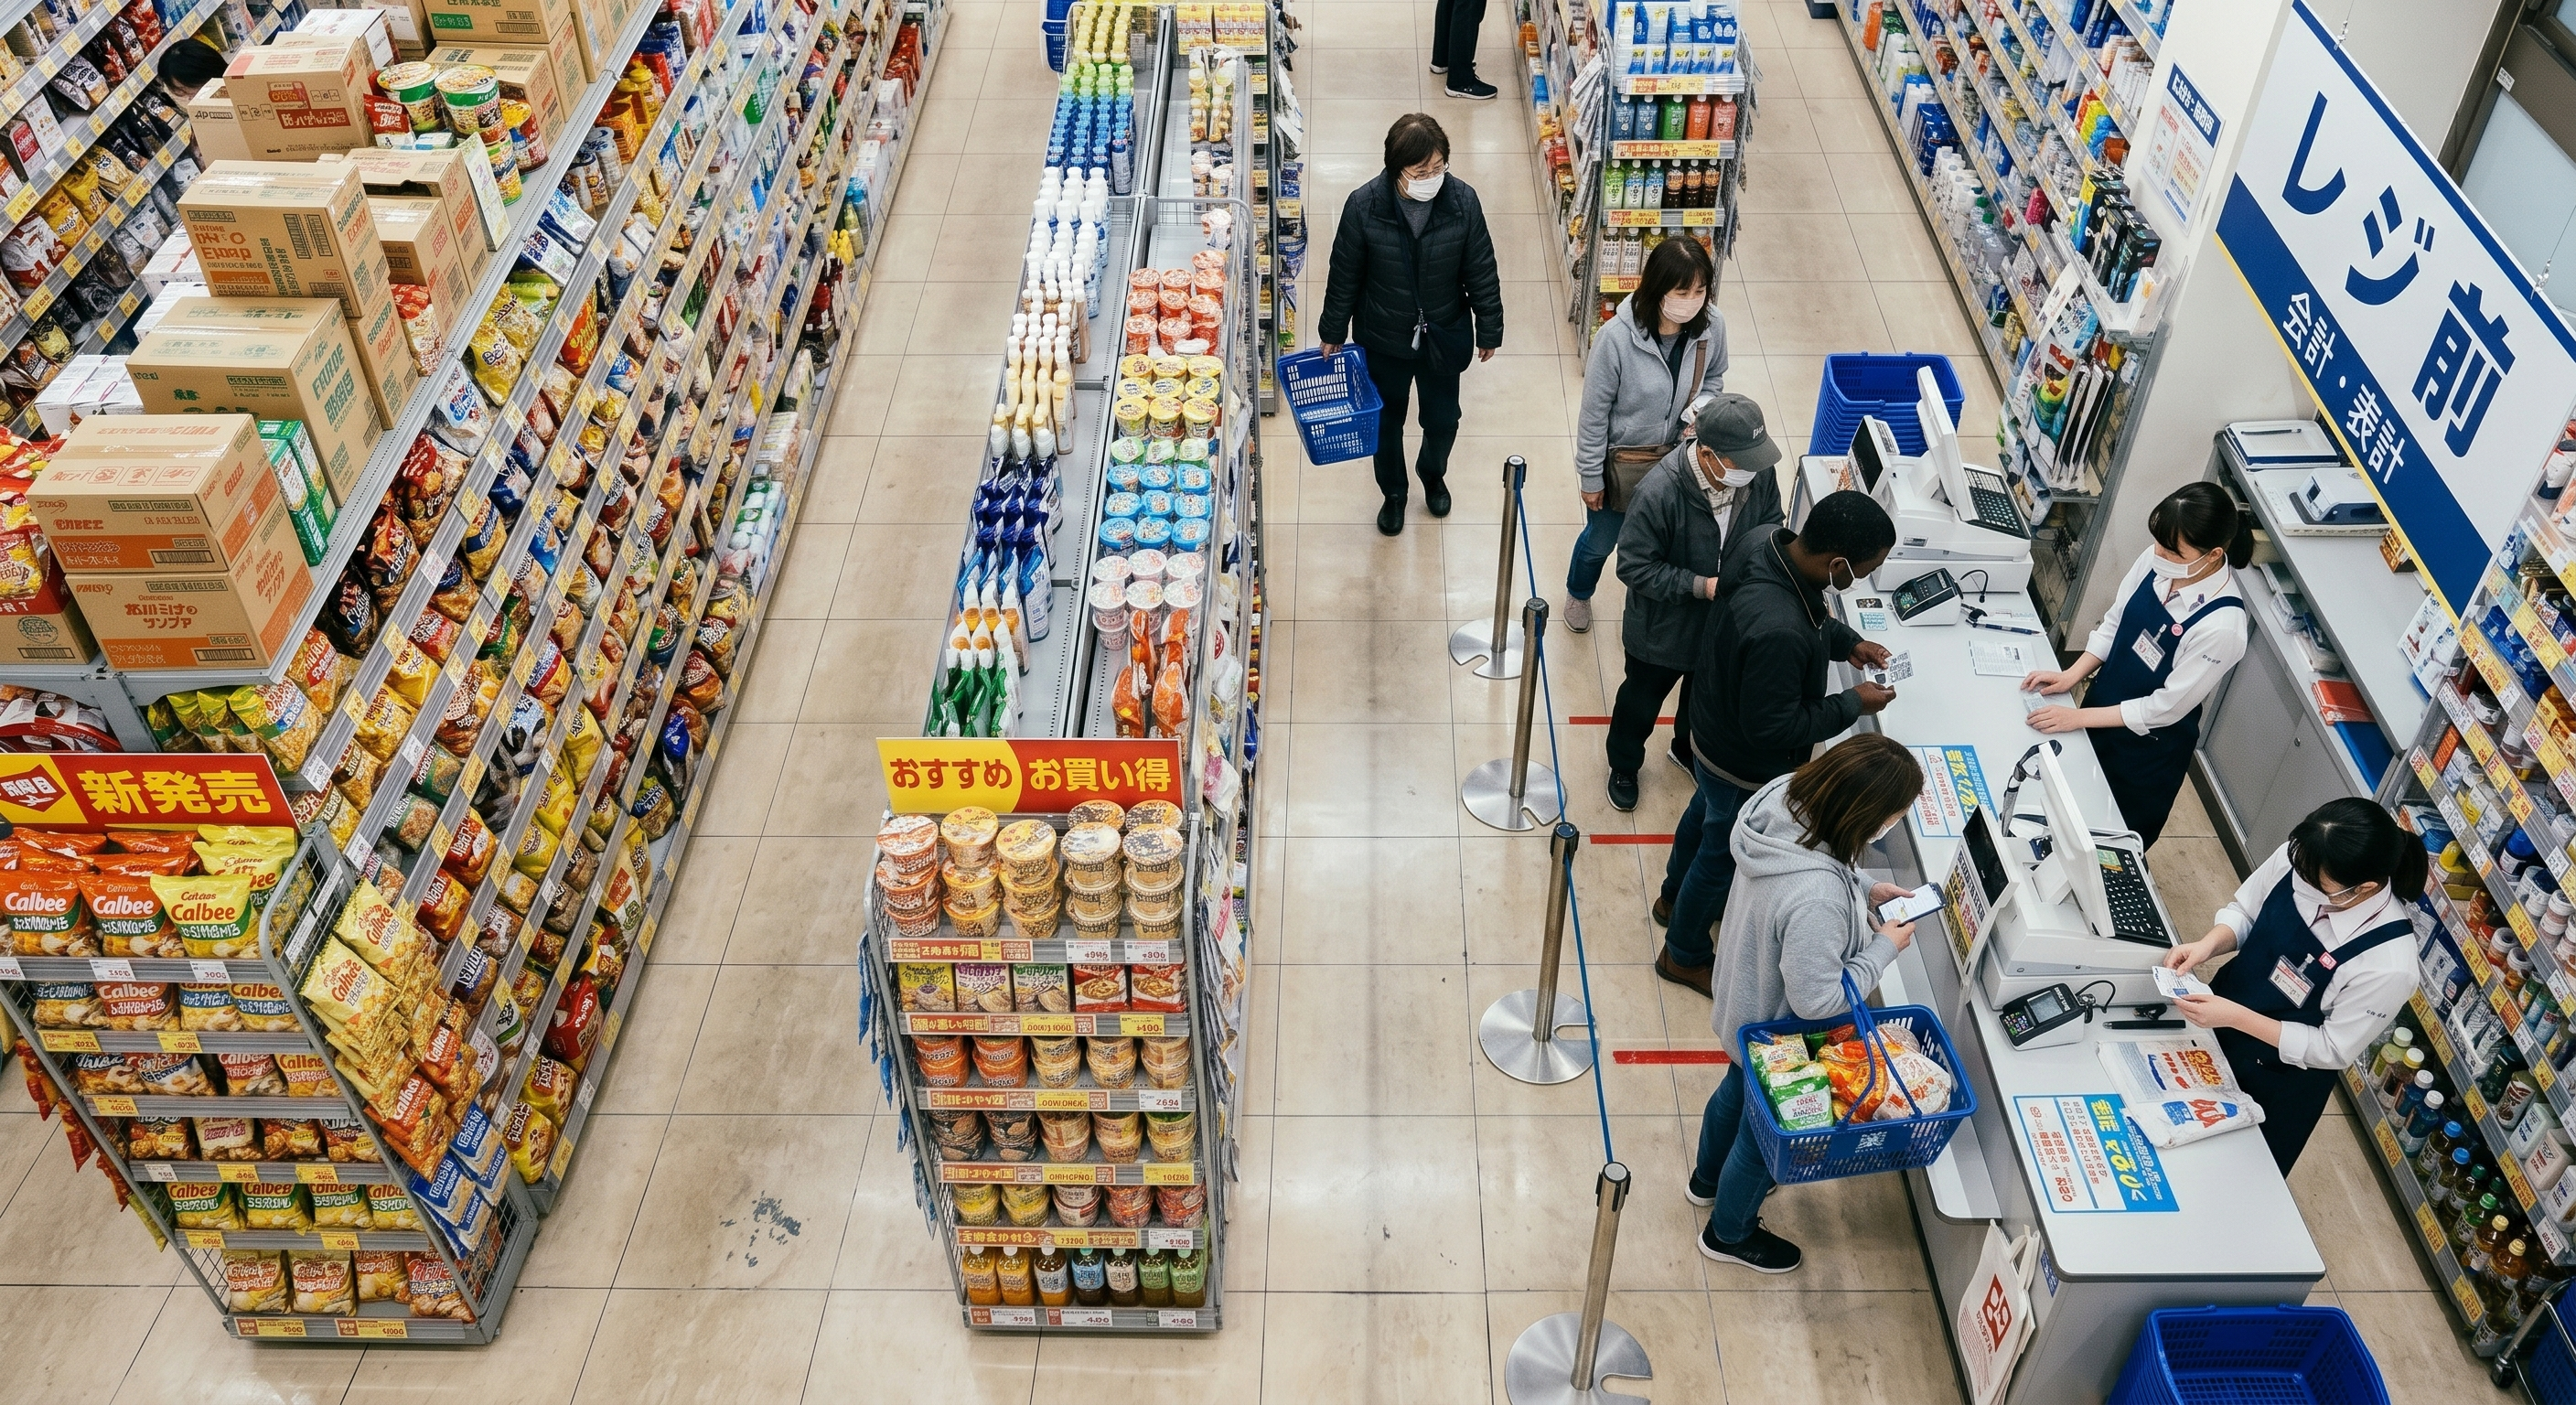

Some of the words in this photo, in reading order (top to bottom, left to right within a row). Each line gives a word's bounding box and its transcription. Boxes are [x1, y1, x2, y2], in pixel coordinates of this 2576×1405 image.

[2281, 90, 2517, 458] レジ前
[889, 757, 1013, 789] おすすめ
[1028, 756, 1172, 792] お買い得
[76, 769, 272, 815] 新発売
[5, 892, 67, 912] Calbee
[92, 896, 155, 915] Calbee
[170, 902, 236, 921] Calbee
[98, 983, 159, 999] Calbee
